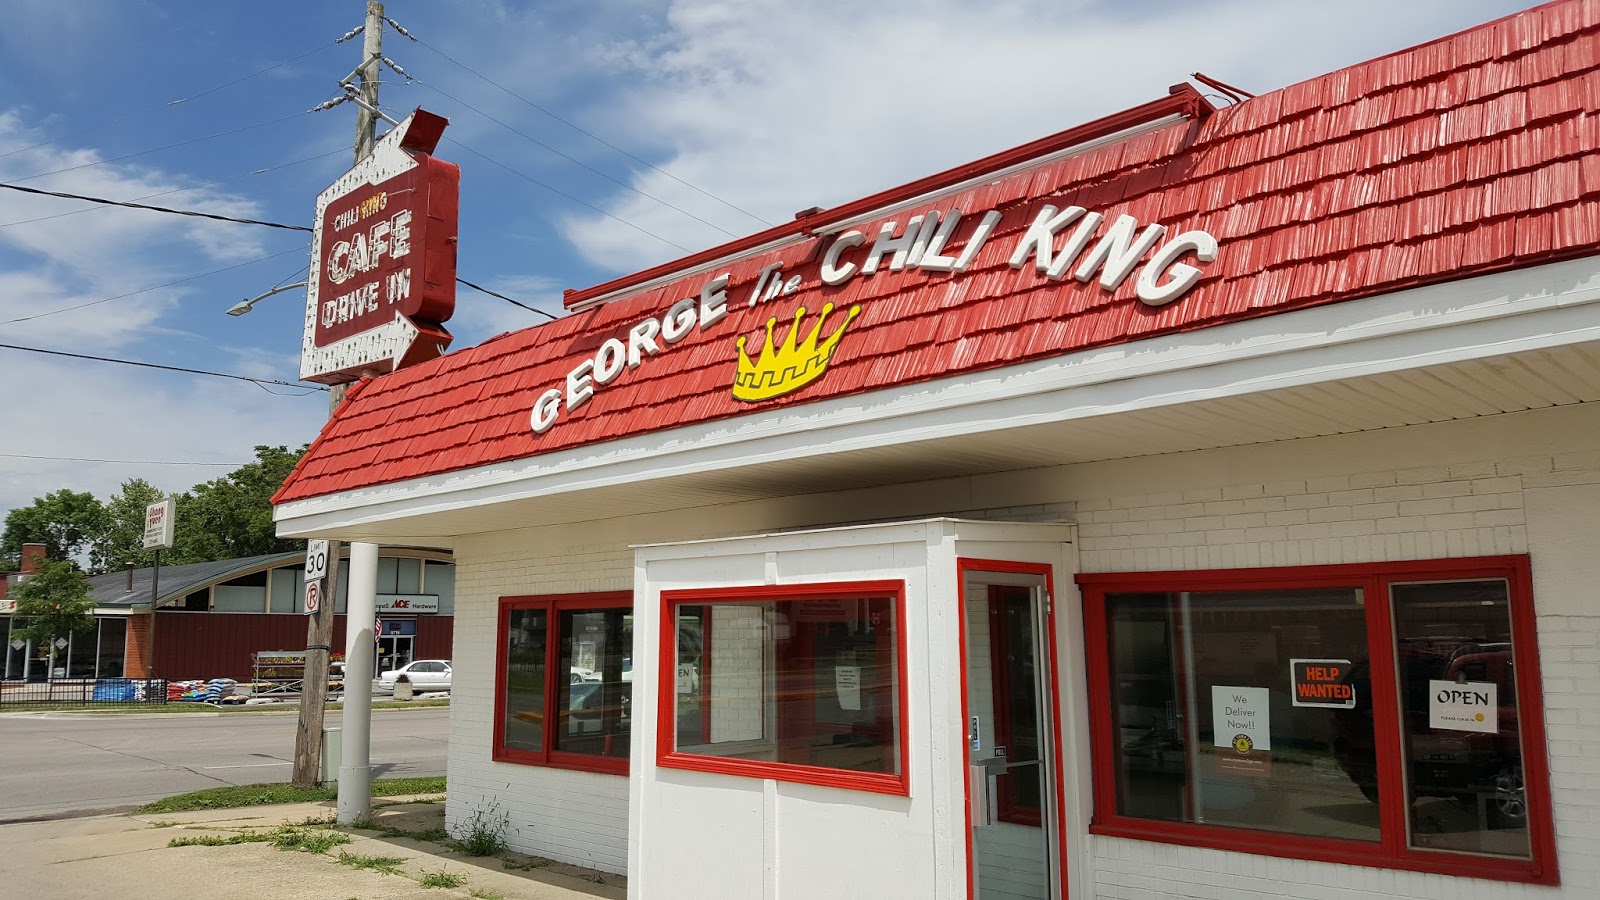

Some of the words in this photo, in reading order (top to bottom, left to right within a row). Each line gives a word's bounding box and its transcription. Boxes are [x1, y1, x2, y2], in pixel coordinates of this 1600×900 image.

[334, 206, 359, 232] CHILI
[360, 192, 387, 219] KING
[327, 209, 412, 284] CAFE
[322, 281, 380, 328] DRIVE
[386, 268, 411, 304] IN
[530, 273, 730, 434] GEORGE
[748, 261, 802, 308] The
[820, 208, 1003, 286] CHILI
[1008, 204, 1218, 306] KING
[310, 541, 325, 552] LIMIT
[307, 552, 325, 574] 30
[391, 599, 410, 608] ACE
[678, 669, 689, 677] EN
[1306, 667, 1339, 681] HELP
[1297, 683, 1351, 699] WANTED
[1437, 690, 1488, 706] OPEN
[1232, 695, 1247, 703] We
[1225, 706, 1256, 717] Deliver
[1227, 719, 1255, 730] Now!!
